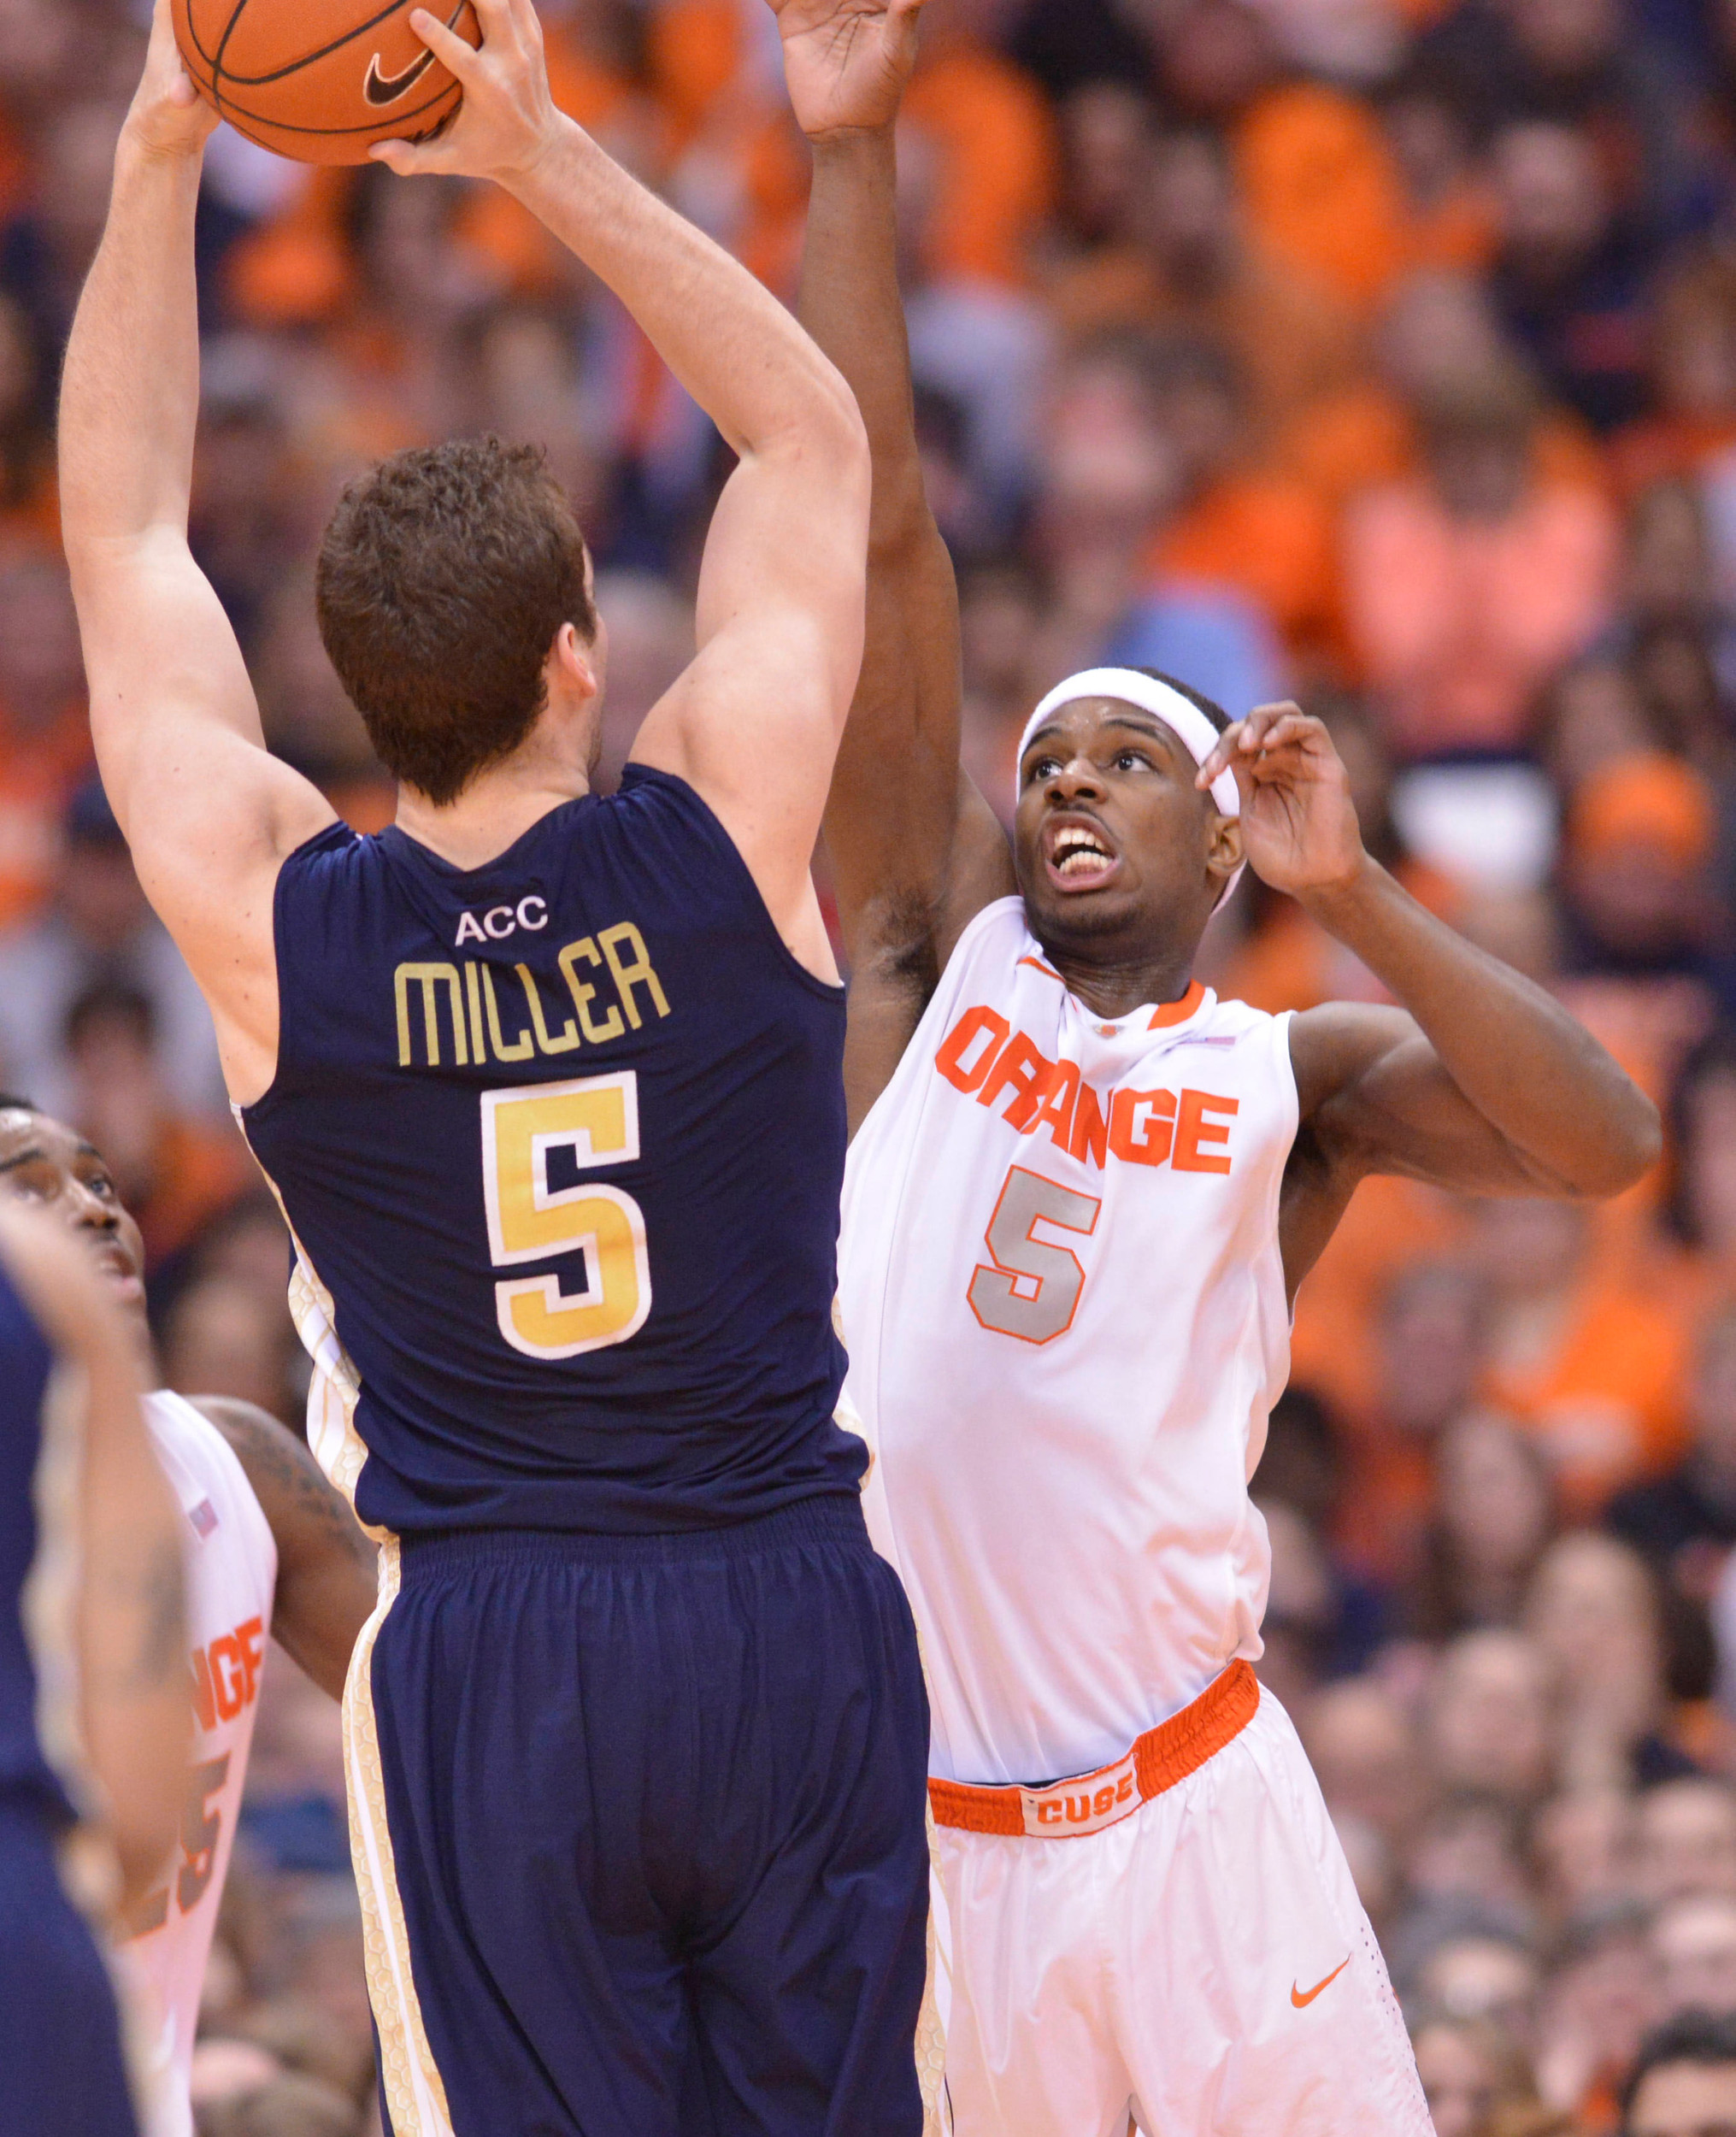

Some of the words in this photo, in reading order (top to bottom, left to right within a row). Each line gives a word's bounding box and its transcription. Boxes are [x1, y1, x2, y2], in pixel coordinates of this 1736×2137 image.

[394, 921, 671, 1067] MILLER
[455, 896, 549, 946] ACC
[935, 1005, 1239, 1175] ORANGE
[480, 1070, 652, 1360] 5
[966, 1164, 1102, 1345] 5
[1037, 1771, 1133, 1824] CUSE
